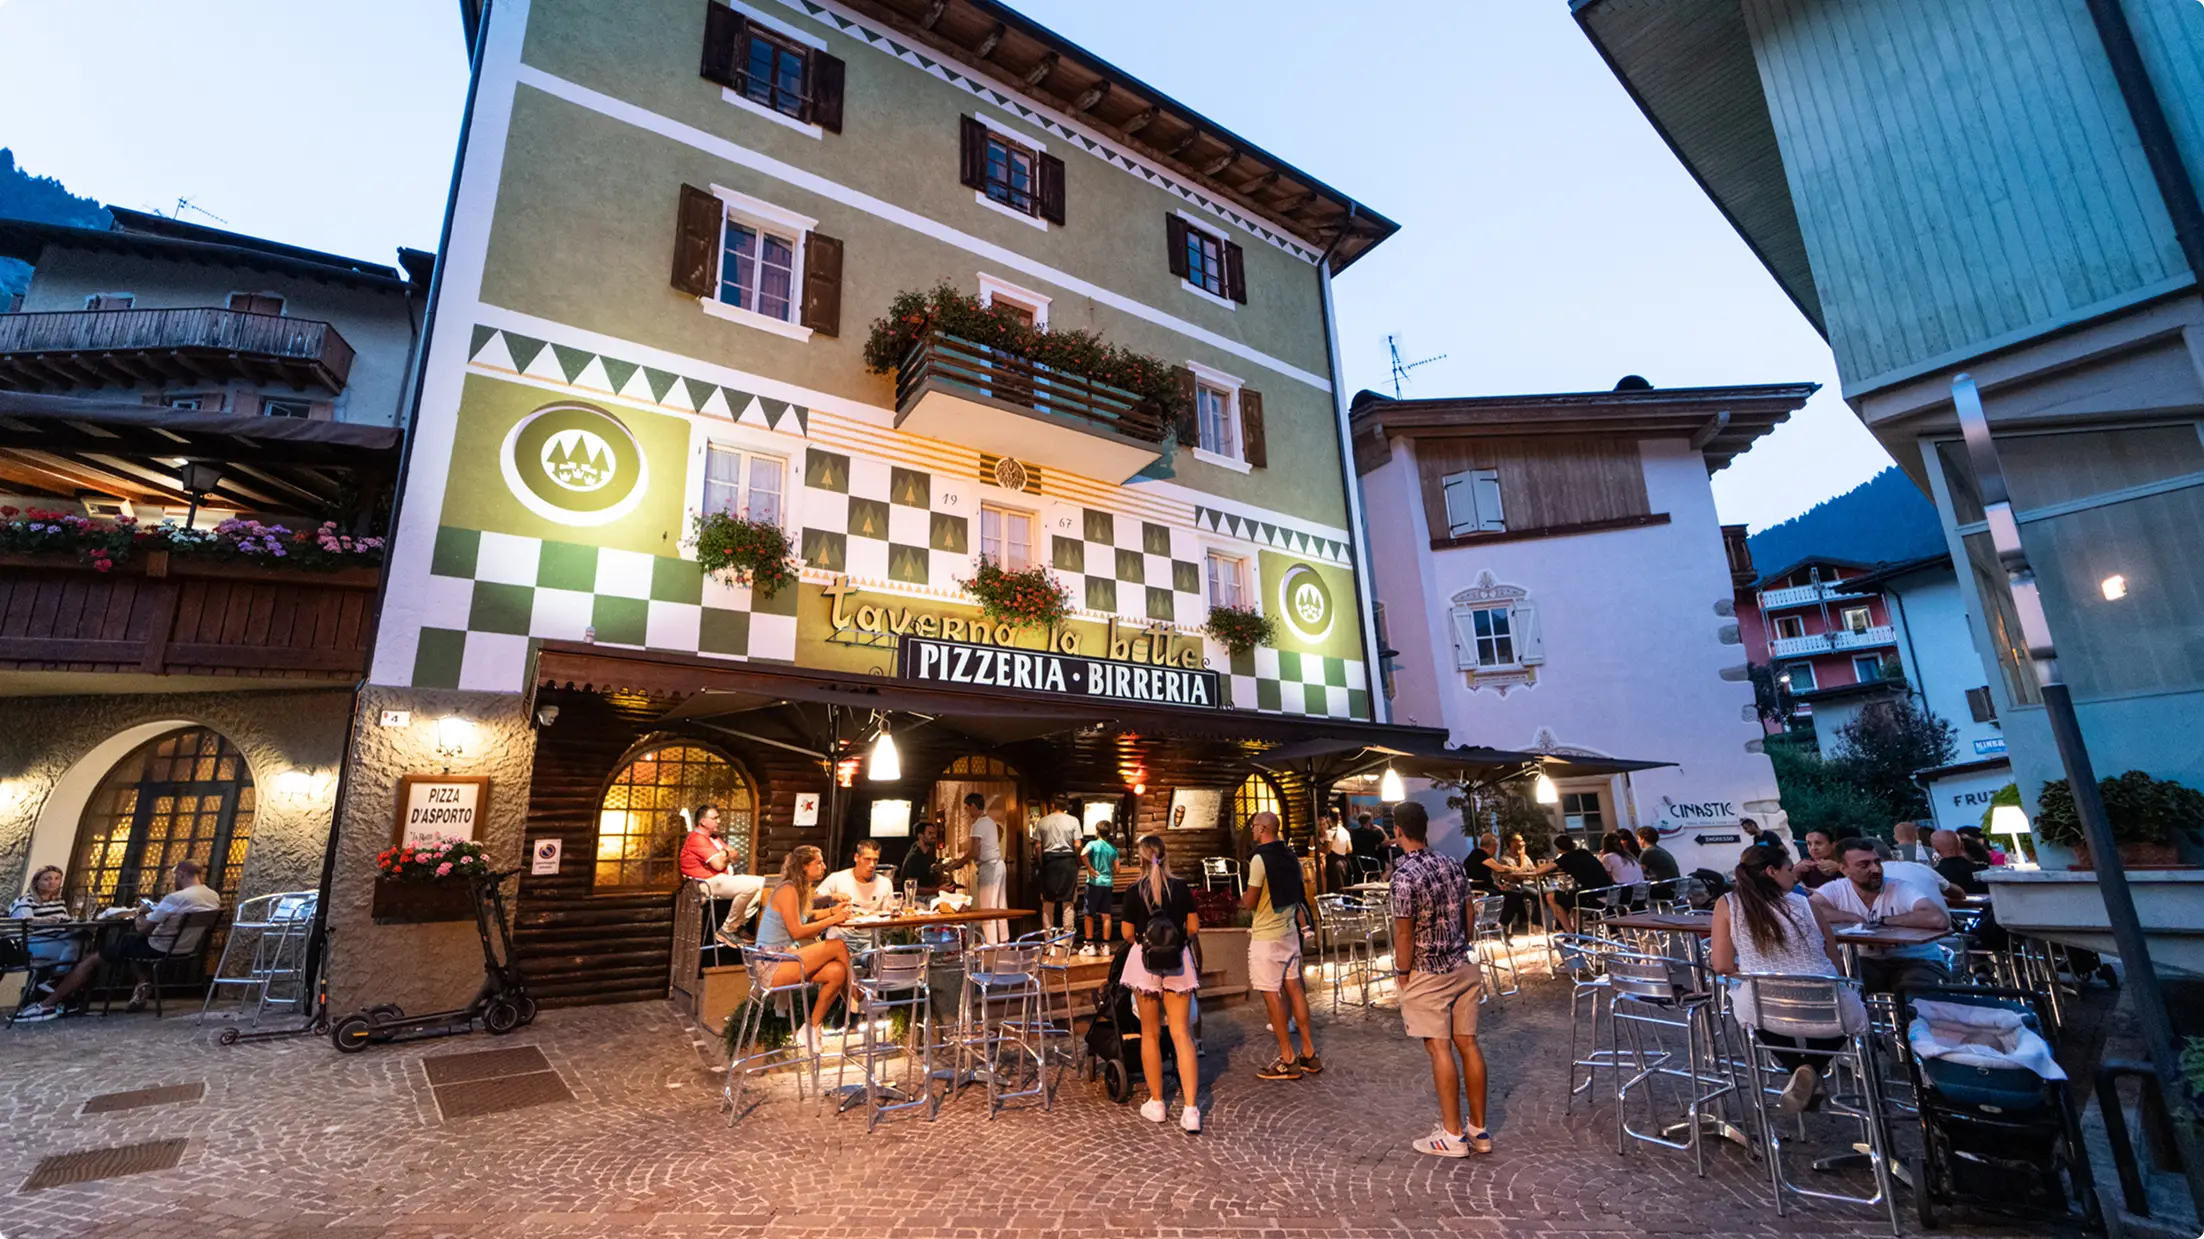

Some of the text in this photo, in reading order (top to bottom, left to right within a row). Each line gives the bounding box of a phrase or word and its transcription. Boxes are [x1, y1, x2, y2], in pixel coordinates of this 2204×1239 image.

[942, 493, 957, 506] 19
[1059, 517, 1072, 529] 67
[821, 576, 1018, 647] taverna
[1048, 624, 1083, 655] la
[918, 643, 1209, 705] PIZZERIA BIRRERIA
[428, 788, 460, 804] PIZZA
[411, 808, 472, 825] D'ASPORTO
[1670, 802, 1735, 818] CINASTIC
